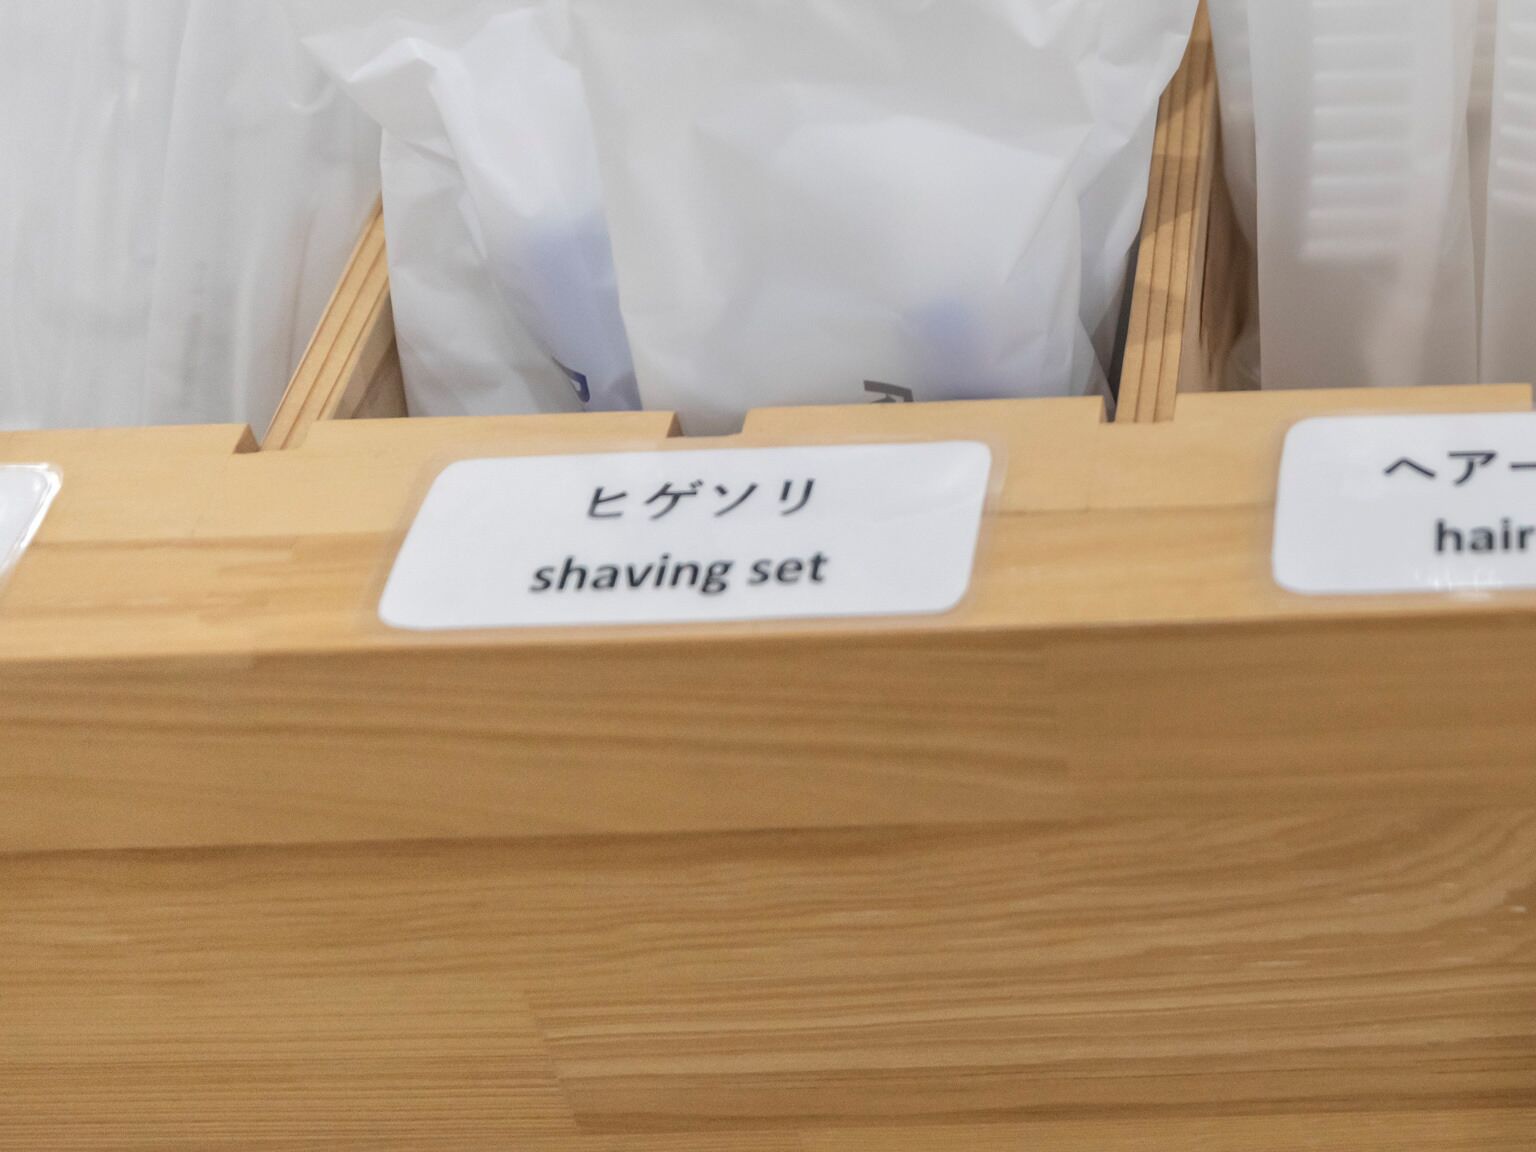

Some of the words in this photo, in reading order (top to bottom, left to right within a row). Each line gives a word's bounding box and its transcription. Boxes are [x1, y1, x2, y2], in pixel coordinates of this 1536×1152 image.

[586, 478, 816, 520] ヒゲソリ
[1434, 518, 1536, 553] hair
[529, 553, 735, 596] shaving
[747, 551, 829, 586] set
